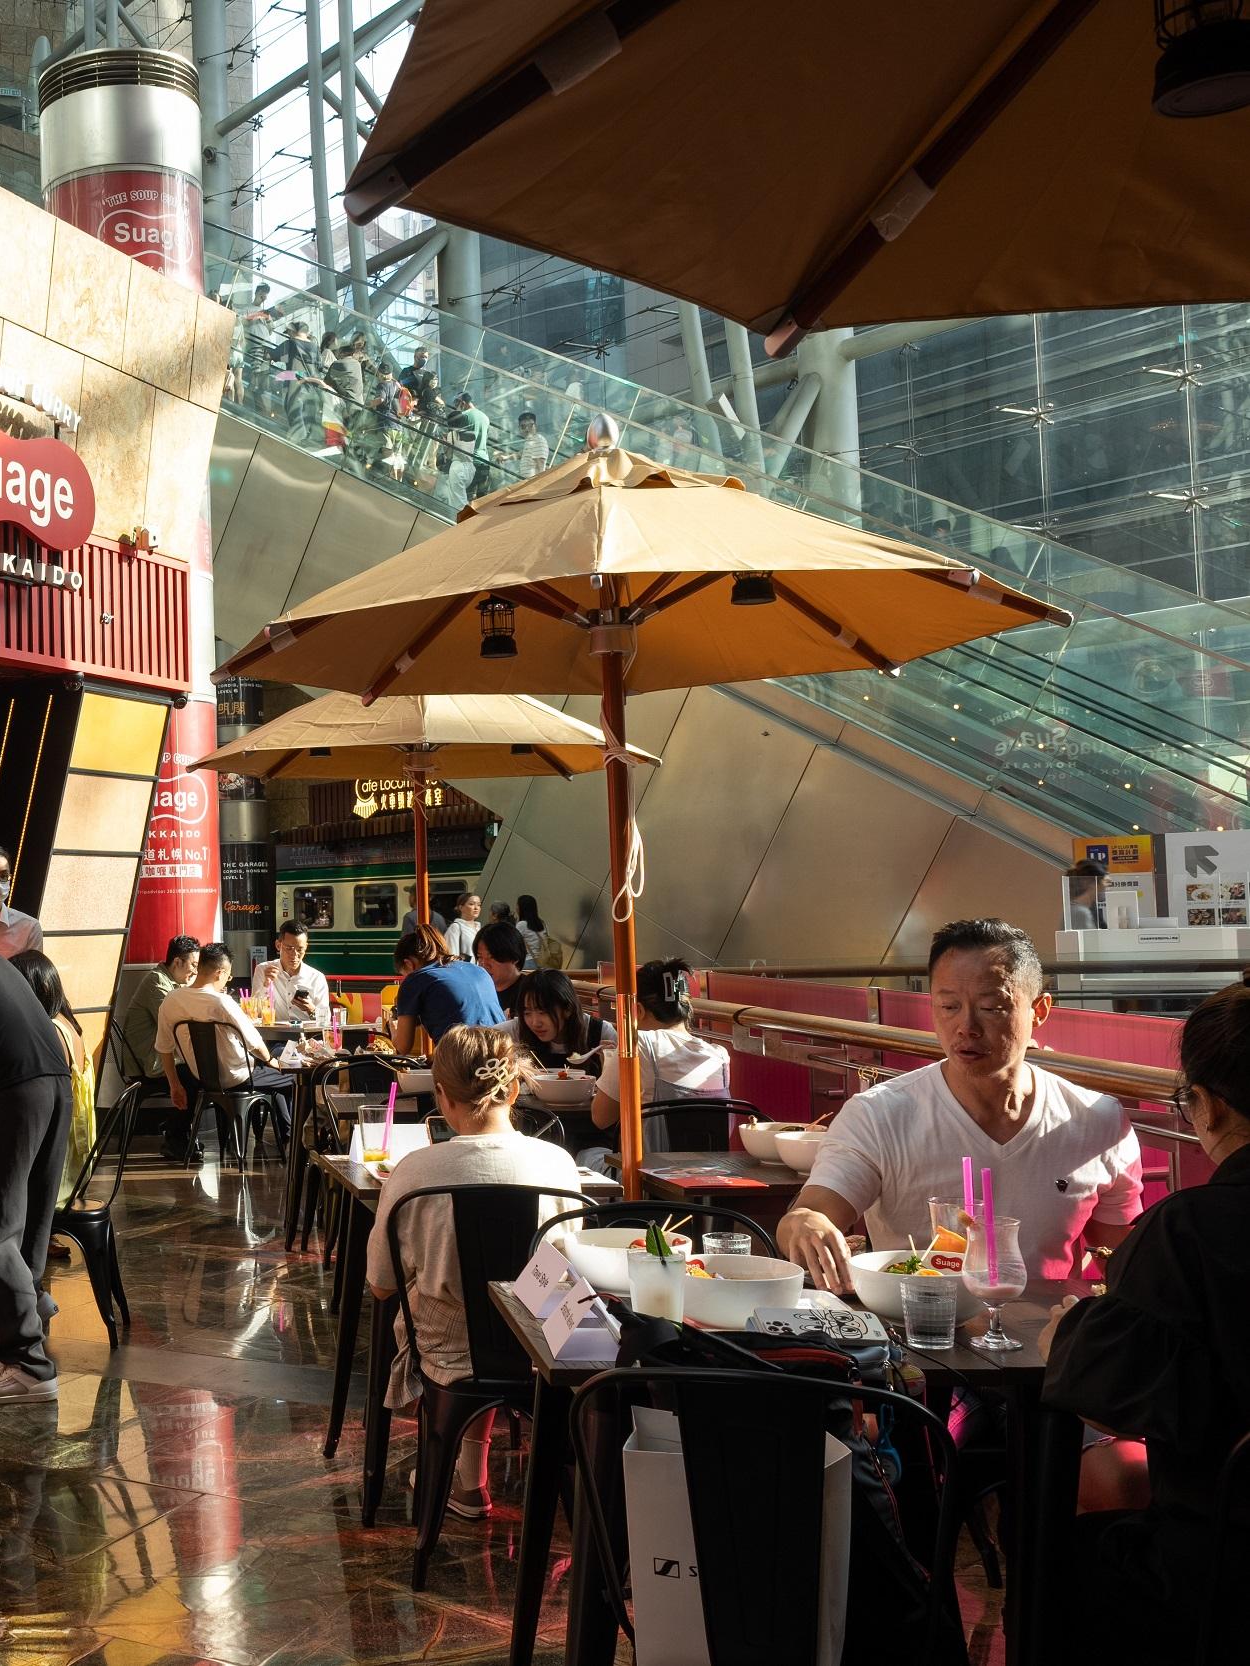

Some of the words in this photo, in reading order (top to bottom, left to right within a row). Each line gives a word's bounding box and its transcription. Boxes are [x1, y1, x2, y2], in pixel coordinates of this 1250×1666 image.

[107, 193, 127, 207] THE
[130, 190, 158, 202] SOUP
[154, 791, 198, 812] age
[148, 830, 201, 838] KKAIDO
[224, 901, 260, 912] Garage
[935, 1258, 960, 1268] Suage
